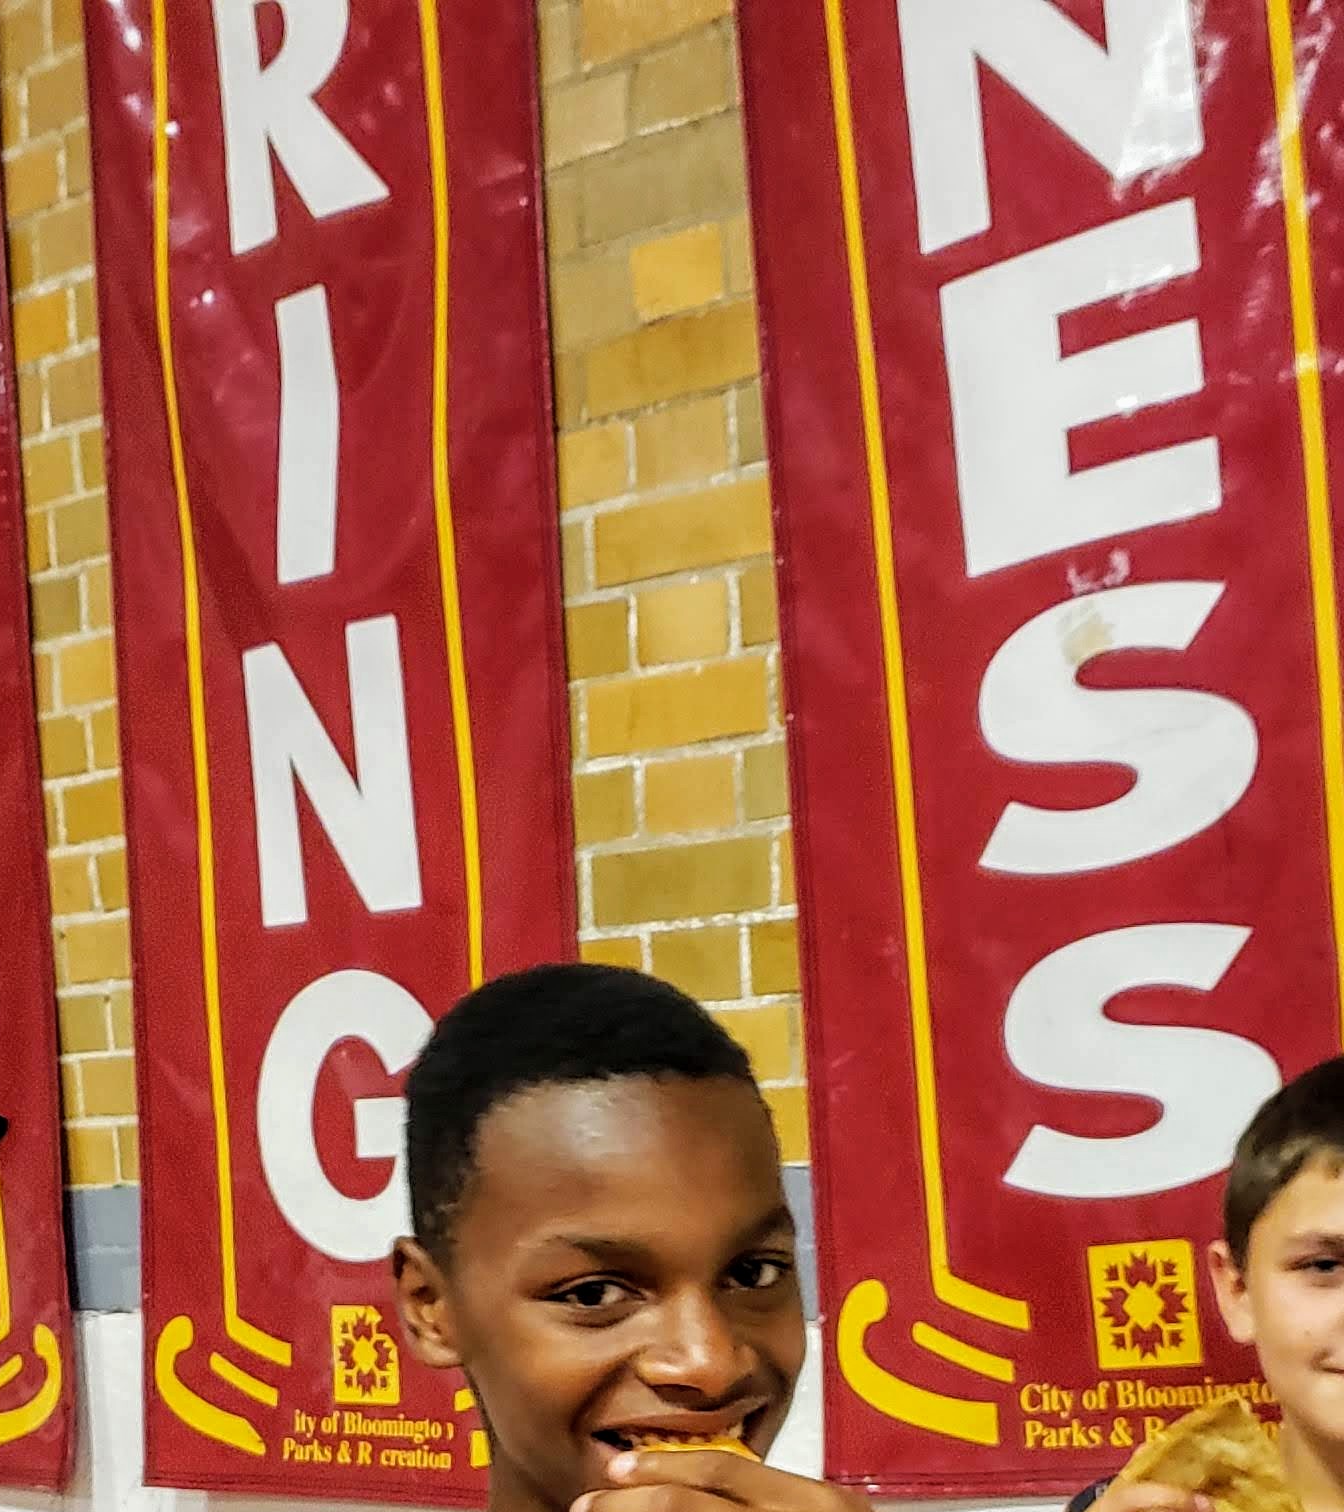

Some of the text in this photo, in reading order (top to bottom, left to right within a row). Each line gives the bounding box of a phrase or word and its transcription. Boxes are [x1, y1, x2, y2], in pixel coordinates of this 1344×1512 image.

[897, 0, 1283, 1199] NESS
[212, 0, 436, 1263] RING
[1020, 1376, 1278, 1418] City of Bloomito
[293, 1408, 317, 1438] ity
[321, 1410, 340, 1434] of
[1024, 1418, 1103, 1449] Parks
[1110, 1416, 1134, 1447] &
[282, 1437, 452, 1470] Parks & Rcreation
